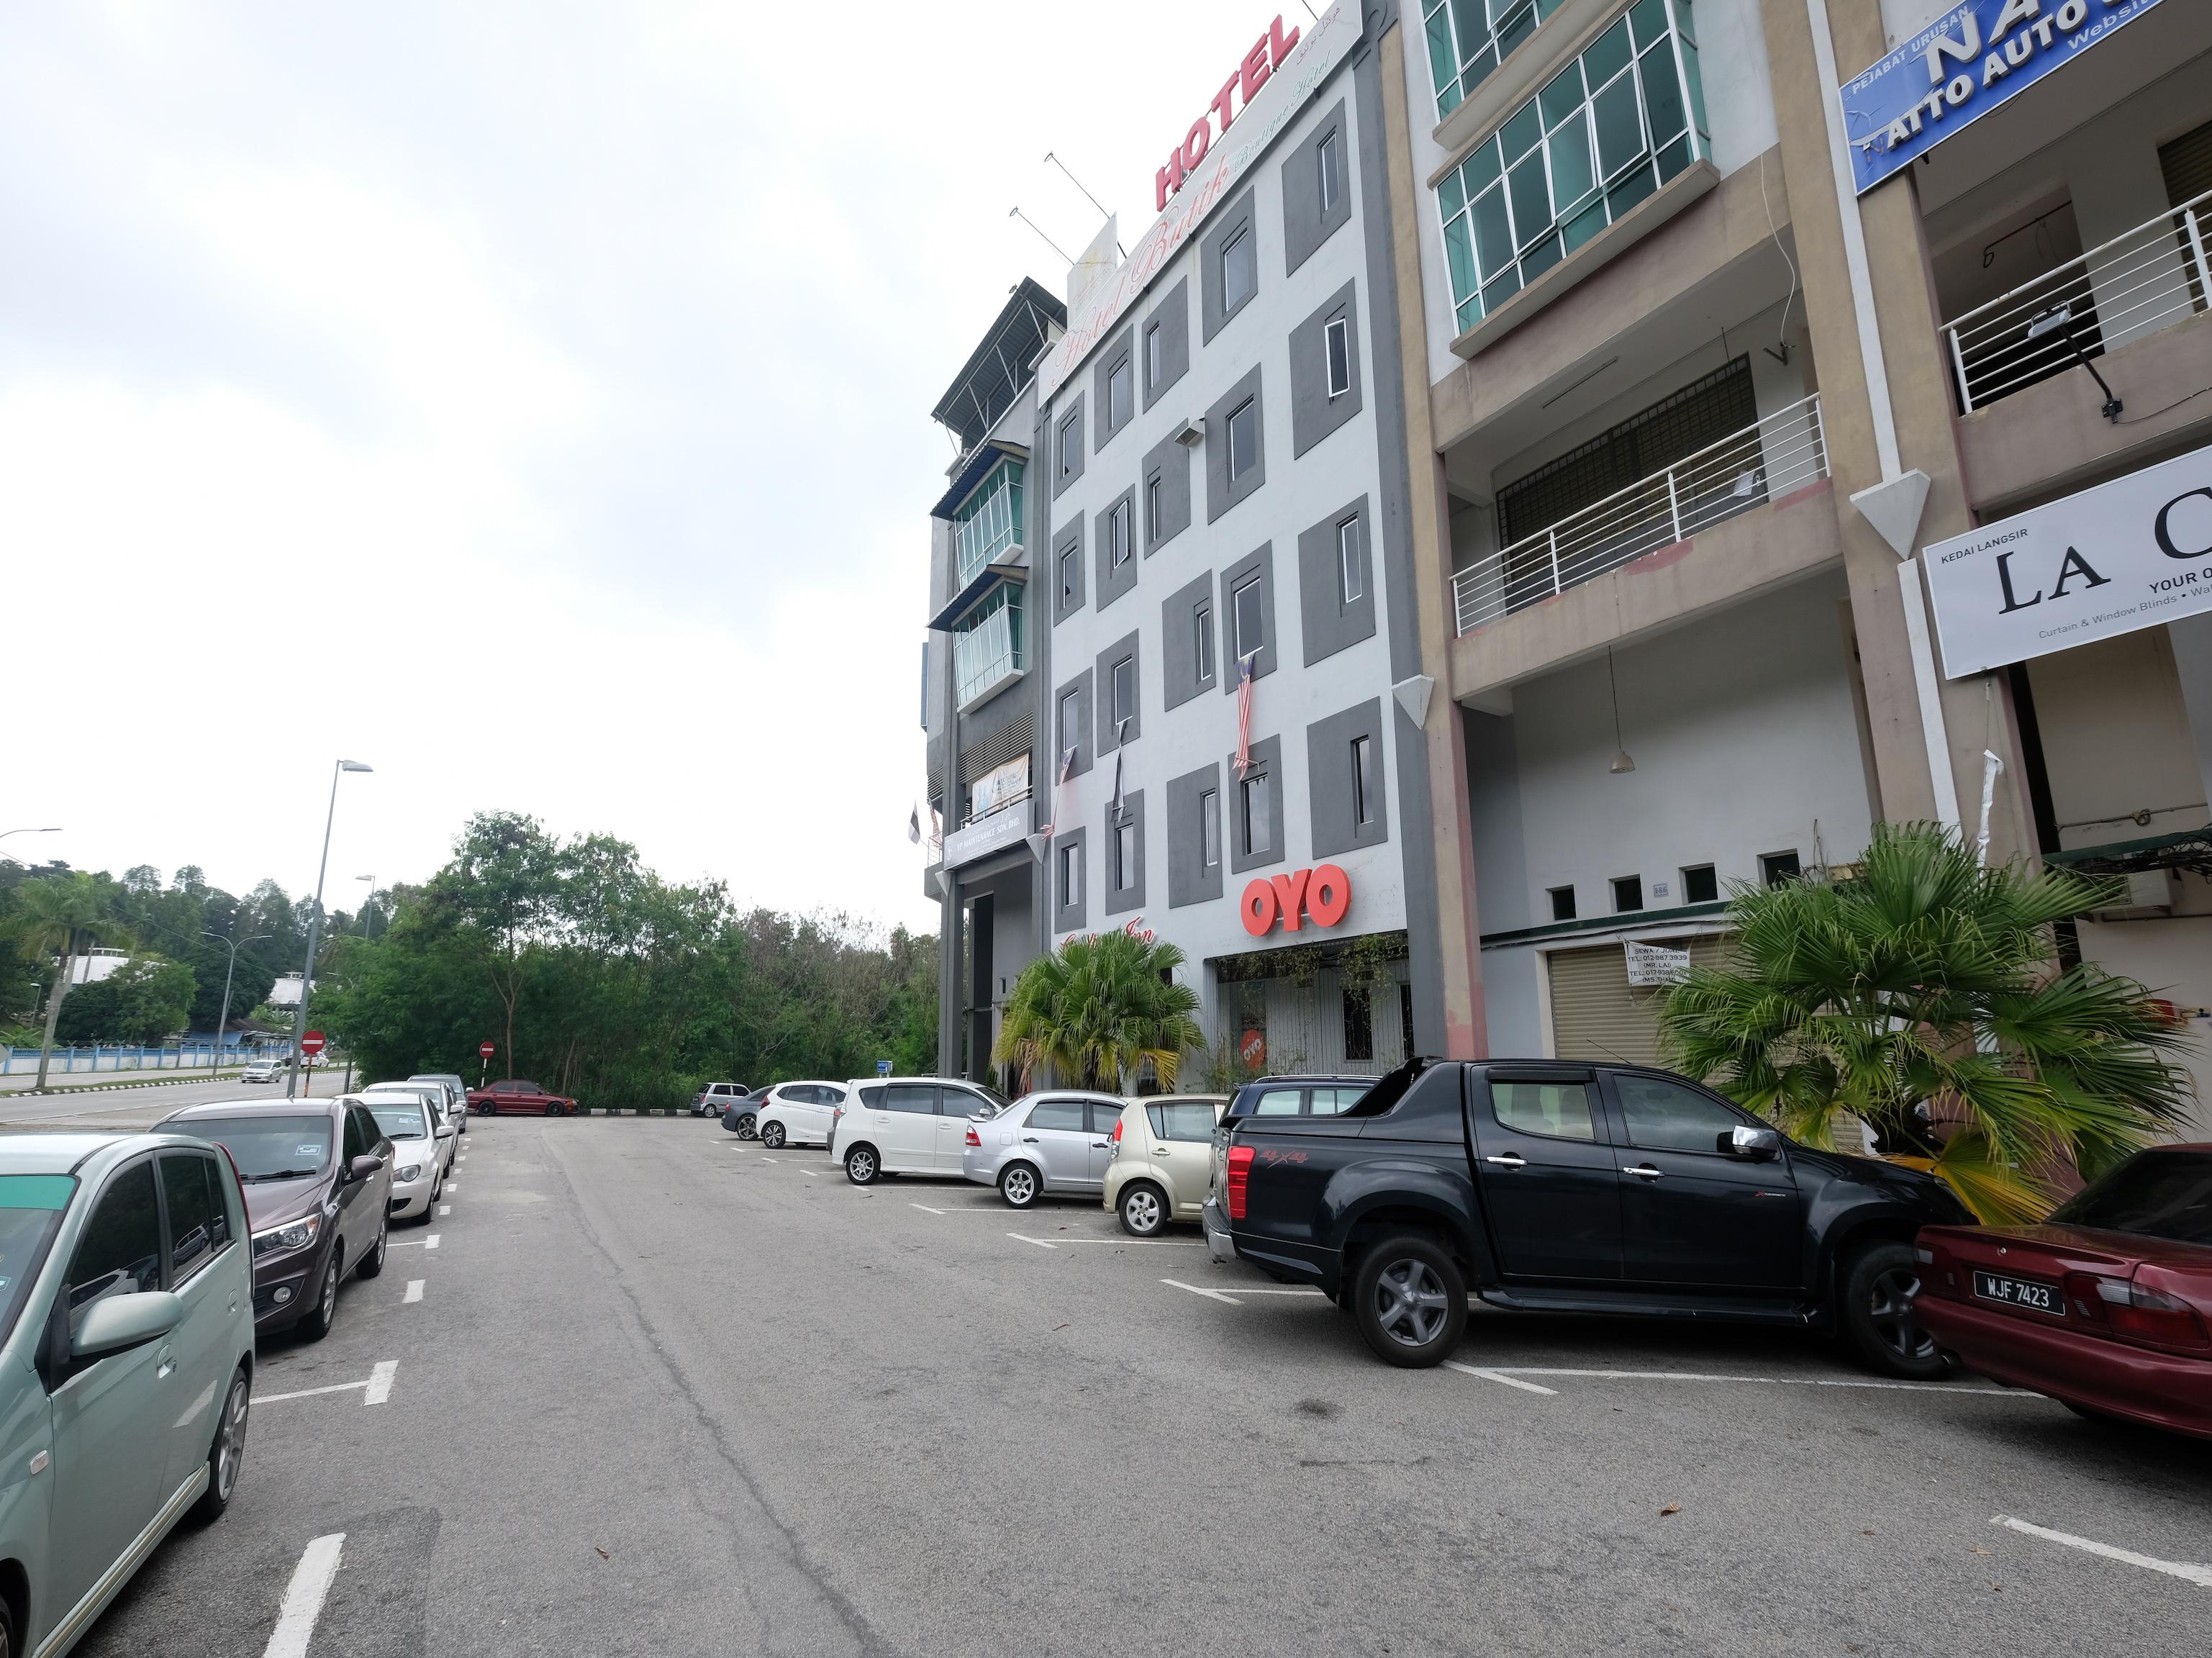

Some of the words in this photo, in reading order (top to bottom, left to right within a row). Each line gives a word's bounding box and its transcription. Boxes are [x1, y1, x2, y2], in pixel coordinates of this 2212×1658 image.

[1852, 50, 1906, 95] PEJABAT
[1910, 5, 1970, 53] URUSAN
[1982, 0, 2088, 86] AUTO
[1156, 14, 1300, 212] HOTEL
[1234, 105, 1289, 173] Boutique
[1291, 47, 1331, 106] Hotel
[1051, 273, 1127, 387] Hotel
[1130, 153, 1230, 295] Butik
[1941, 545, 1975, 564] KEDAI
[1977, 527, 2029, 552] LANGSIR
[1995, 545, 2112, 615] LA
[2039, 623, 2078, 639] Curtain
[2081, 619, 2090, 628] &
[2092, 606, 2136, 624] Window
[2139, 594, 2177, 611] Blinds
[2149, 572, 2198, 594] YOUR
[964, 828, 996, 848] MAINTENANCE
[1008, 817, 1020, 830] BHD.
[1241, 863, 1352, 937] OYO
[1243, 1038, 1261, 1061] OYO
[1987, 1277, 2013, 1300] WJF
[2016, 1283, 2050, 1308] 7423
